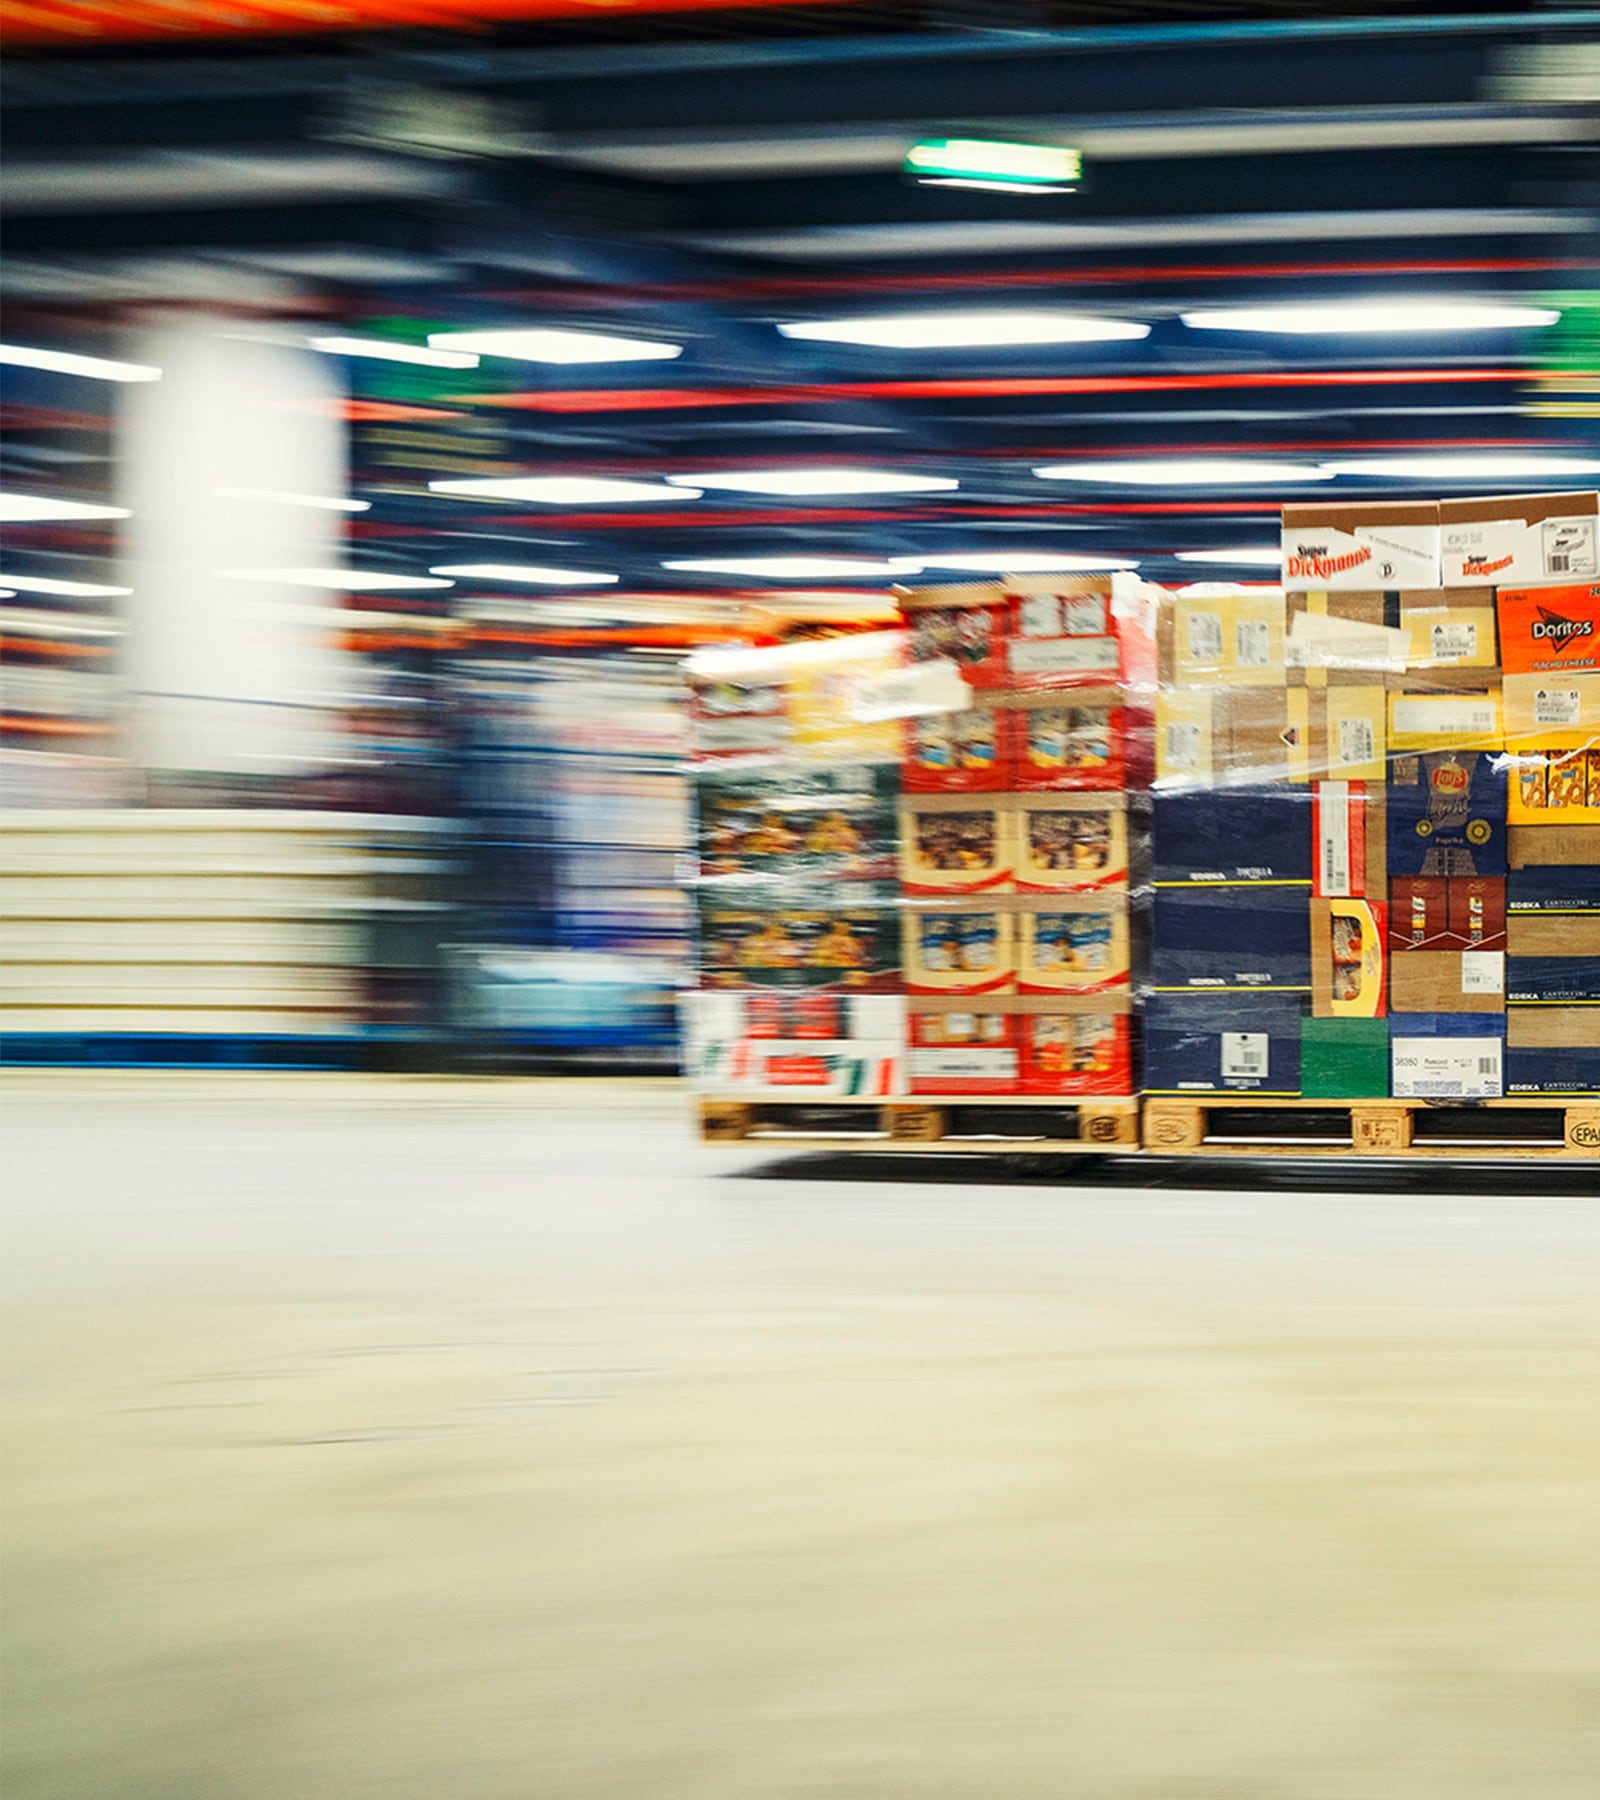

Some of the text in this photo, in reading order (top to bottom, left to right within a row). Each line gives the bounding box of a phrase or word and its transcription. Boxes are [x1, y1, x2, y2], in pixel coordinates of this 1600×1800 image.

[1297, 544, 1328, 558] Super
[1287, 546, 1372, 579] Dickmann's
[1532, 620, 1593, 639] Doritos
[1533, 657, 1596, 670] NACHO CHEESE
